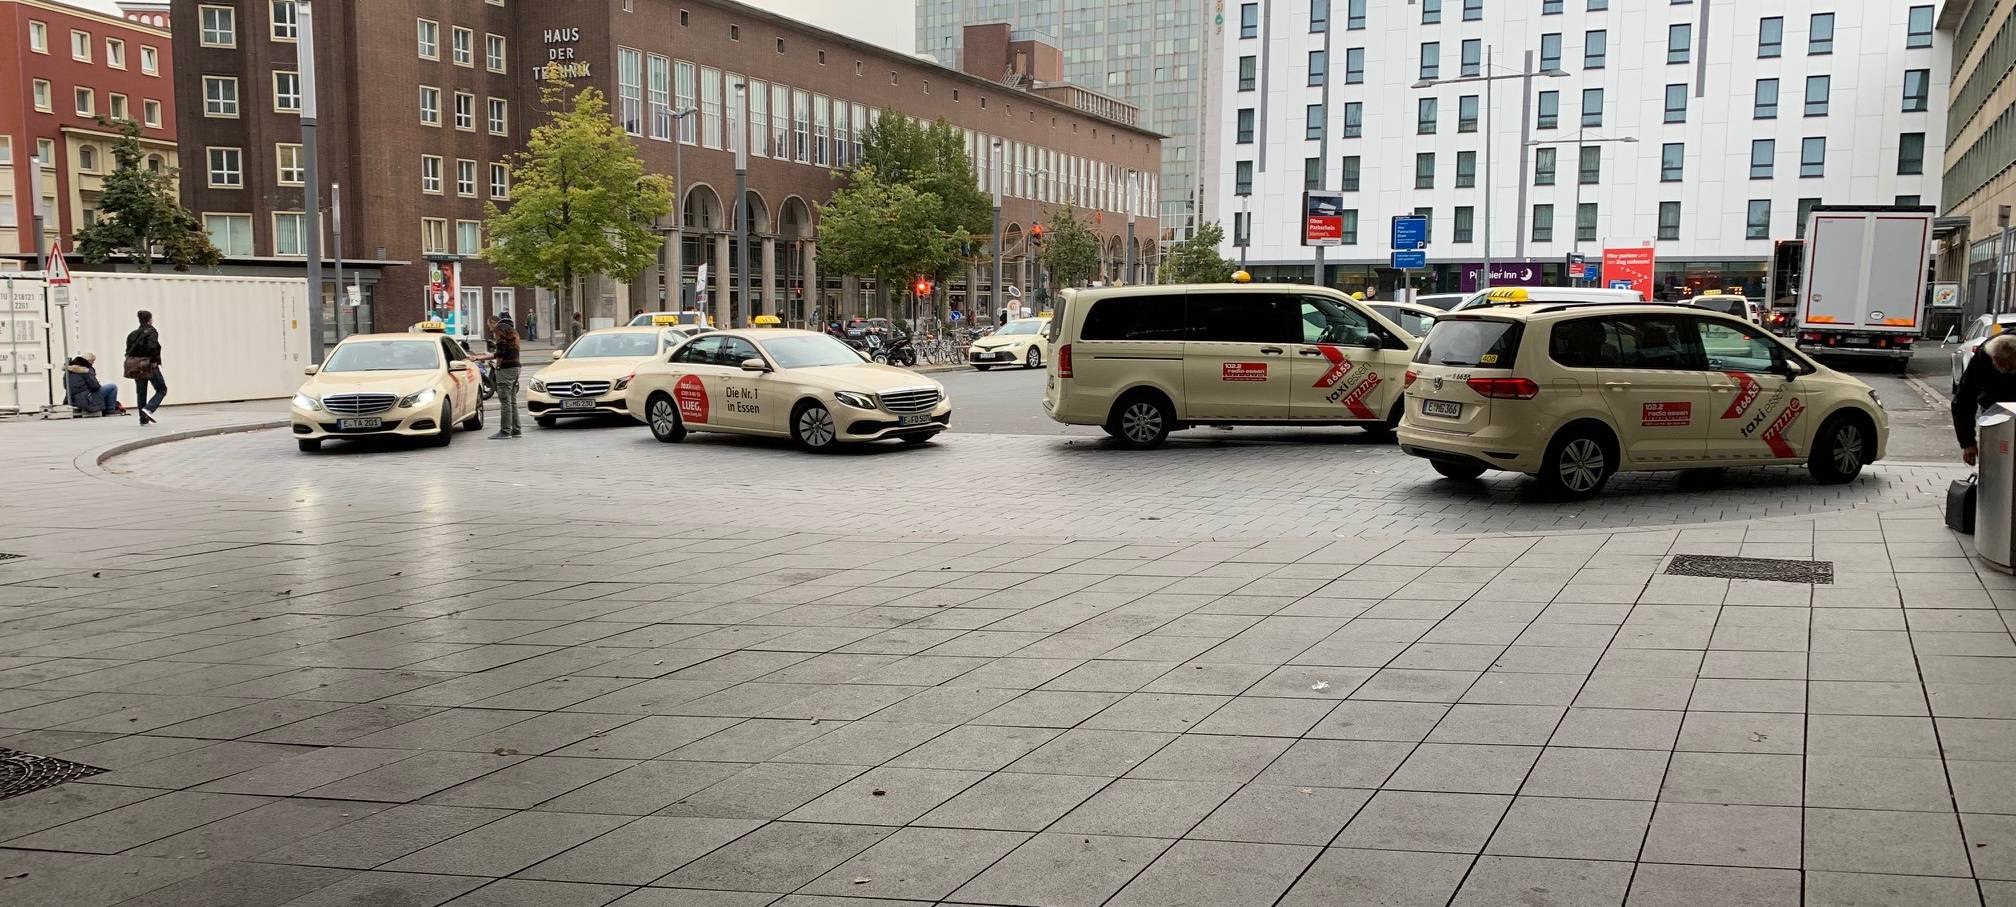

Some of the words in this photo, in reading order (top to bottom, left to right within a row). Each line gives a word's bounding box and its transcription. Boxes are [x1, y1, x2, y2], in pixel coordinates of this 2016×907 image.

[544, 27, 579, 43] HAUS
[549, 47, 574, 60] DER
[1417, 241, 1424, 249] P
[1503, 270, 1517, 279] Inn
[726, 386, 739, 398] Die
[741, 388, 753, 400] Nr.
[754, 388, 758, 399] 1
[727, 400, 736, 412] in
[737, 401, 760, 414] Essen
